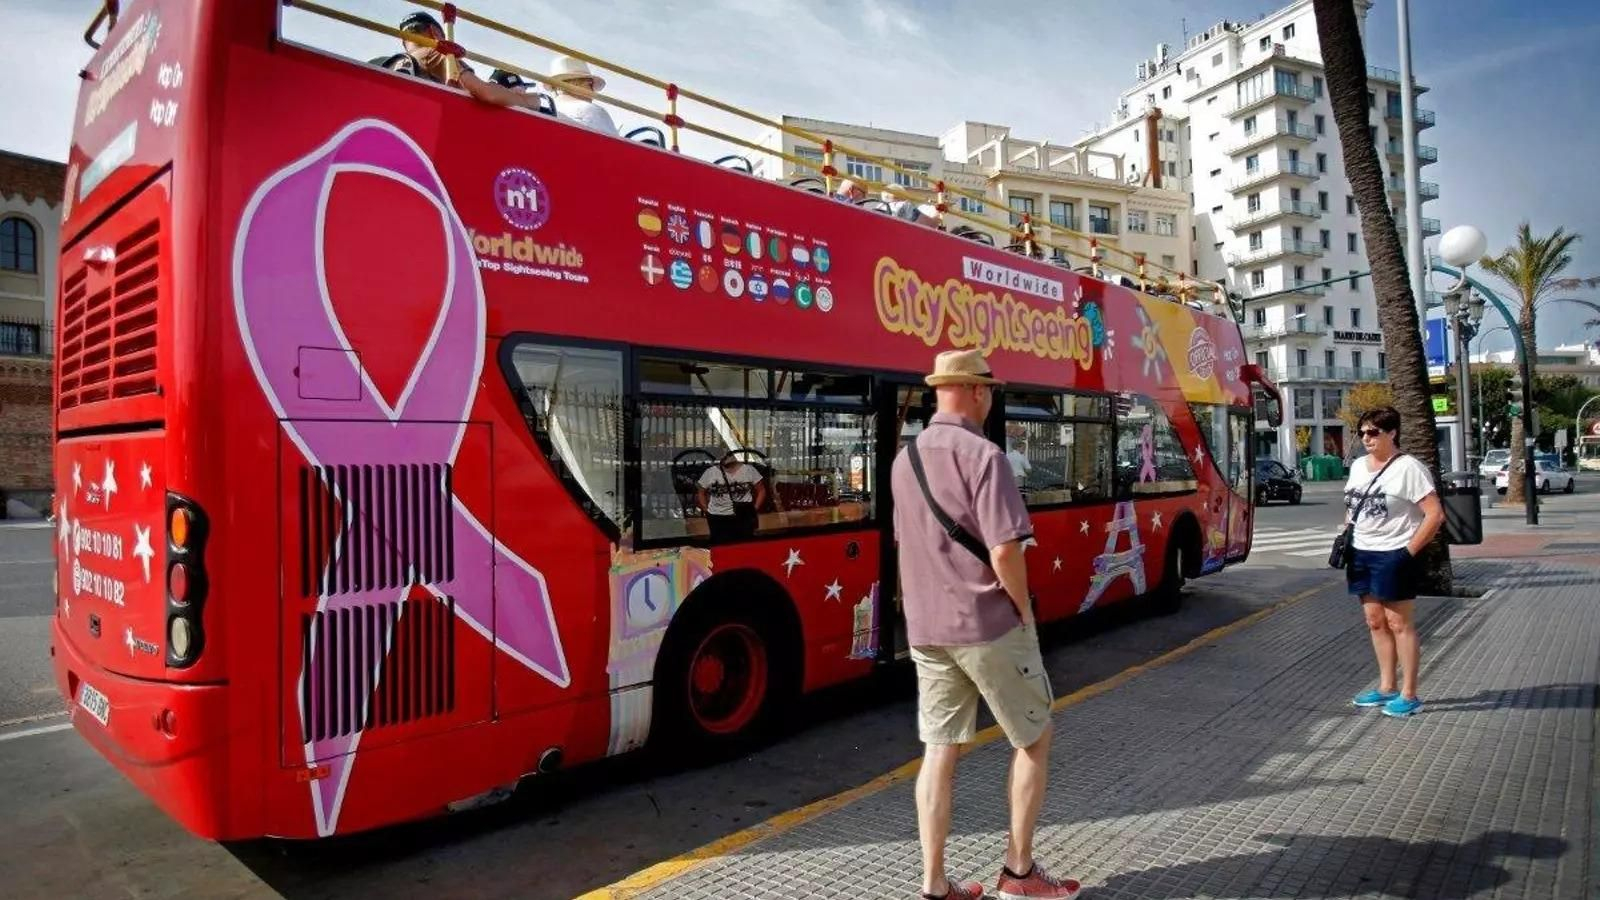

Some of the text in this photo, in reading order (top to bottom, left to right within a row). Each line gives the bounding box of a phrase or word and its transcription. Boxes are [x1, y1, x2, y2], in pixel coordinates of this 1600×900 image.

[503, 262, 562, 280] Sightseeing
[563, 270, 589, 283] Tours
[970, 260, 1058, 298] Worldwide
[103, 533, 112, 558] 10
[104, 576, 112, 601] 10
[114, 579, 125, 606] 82
